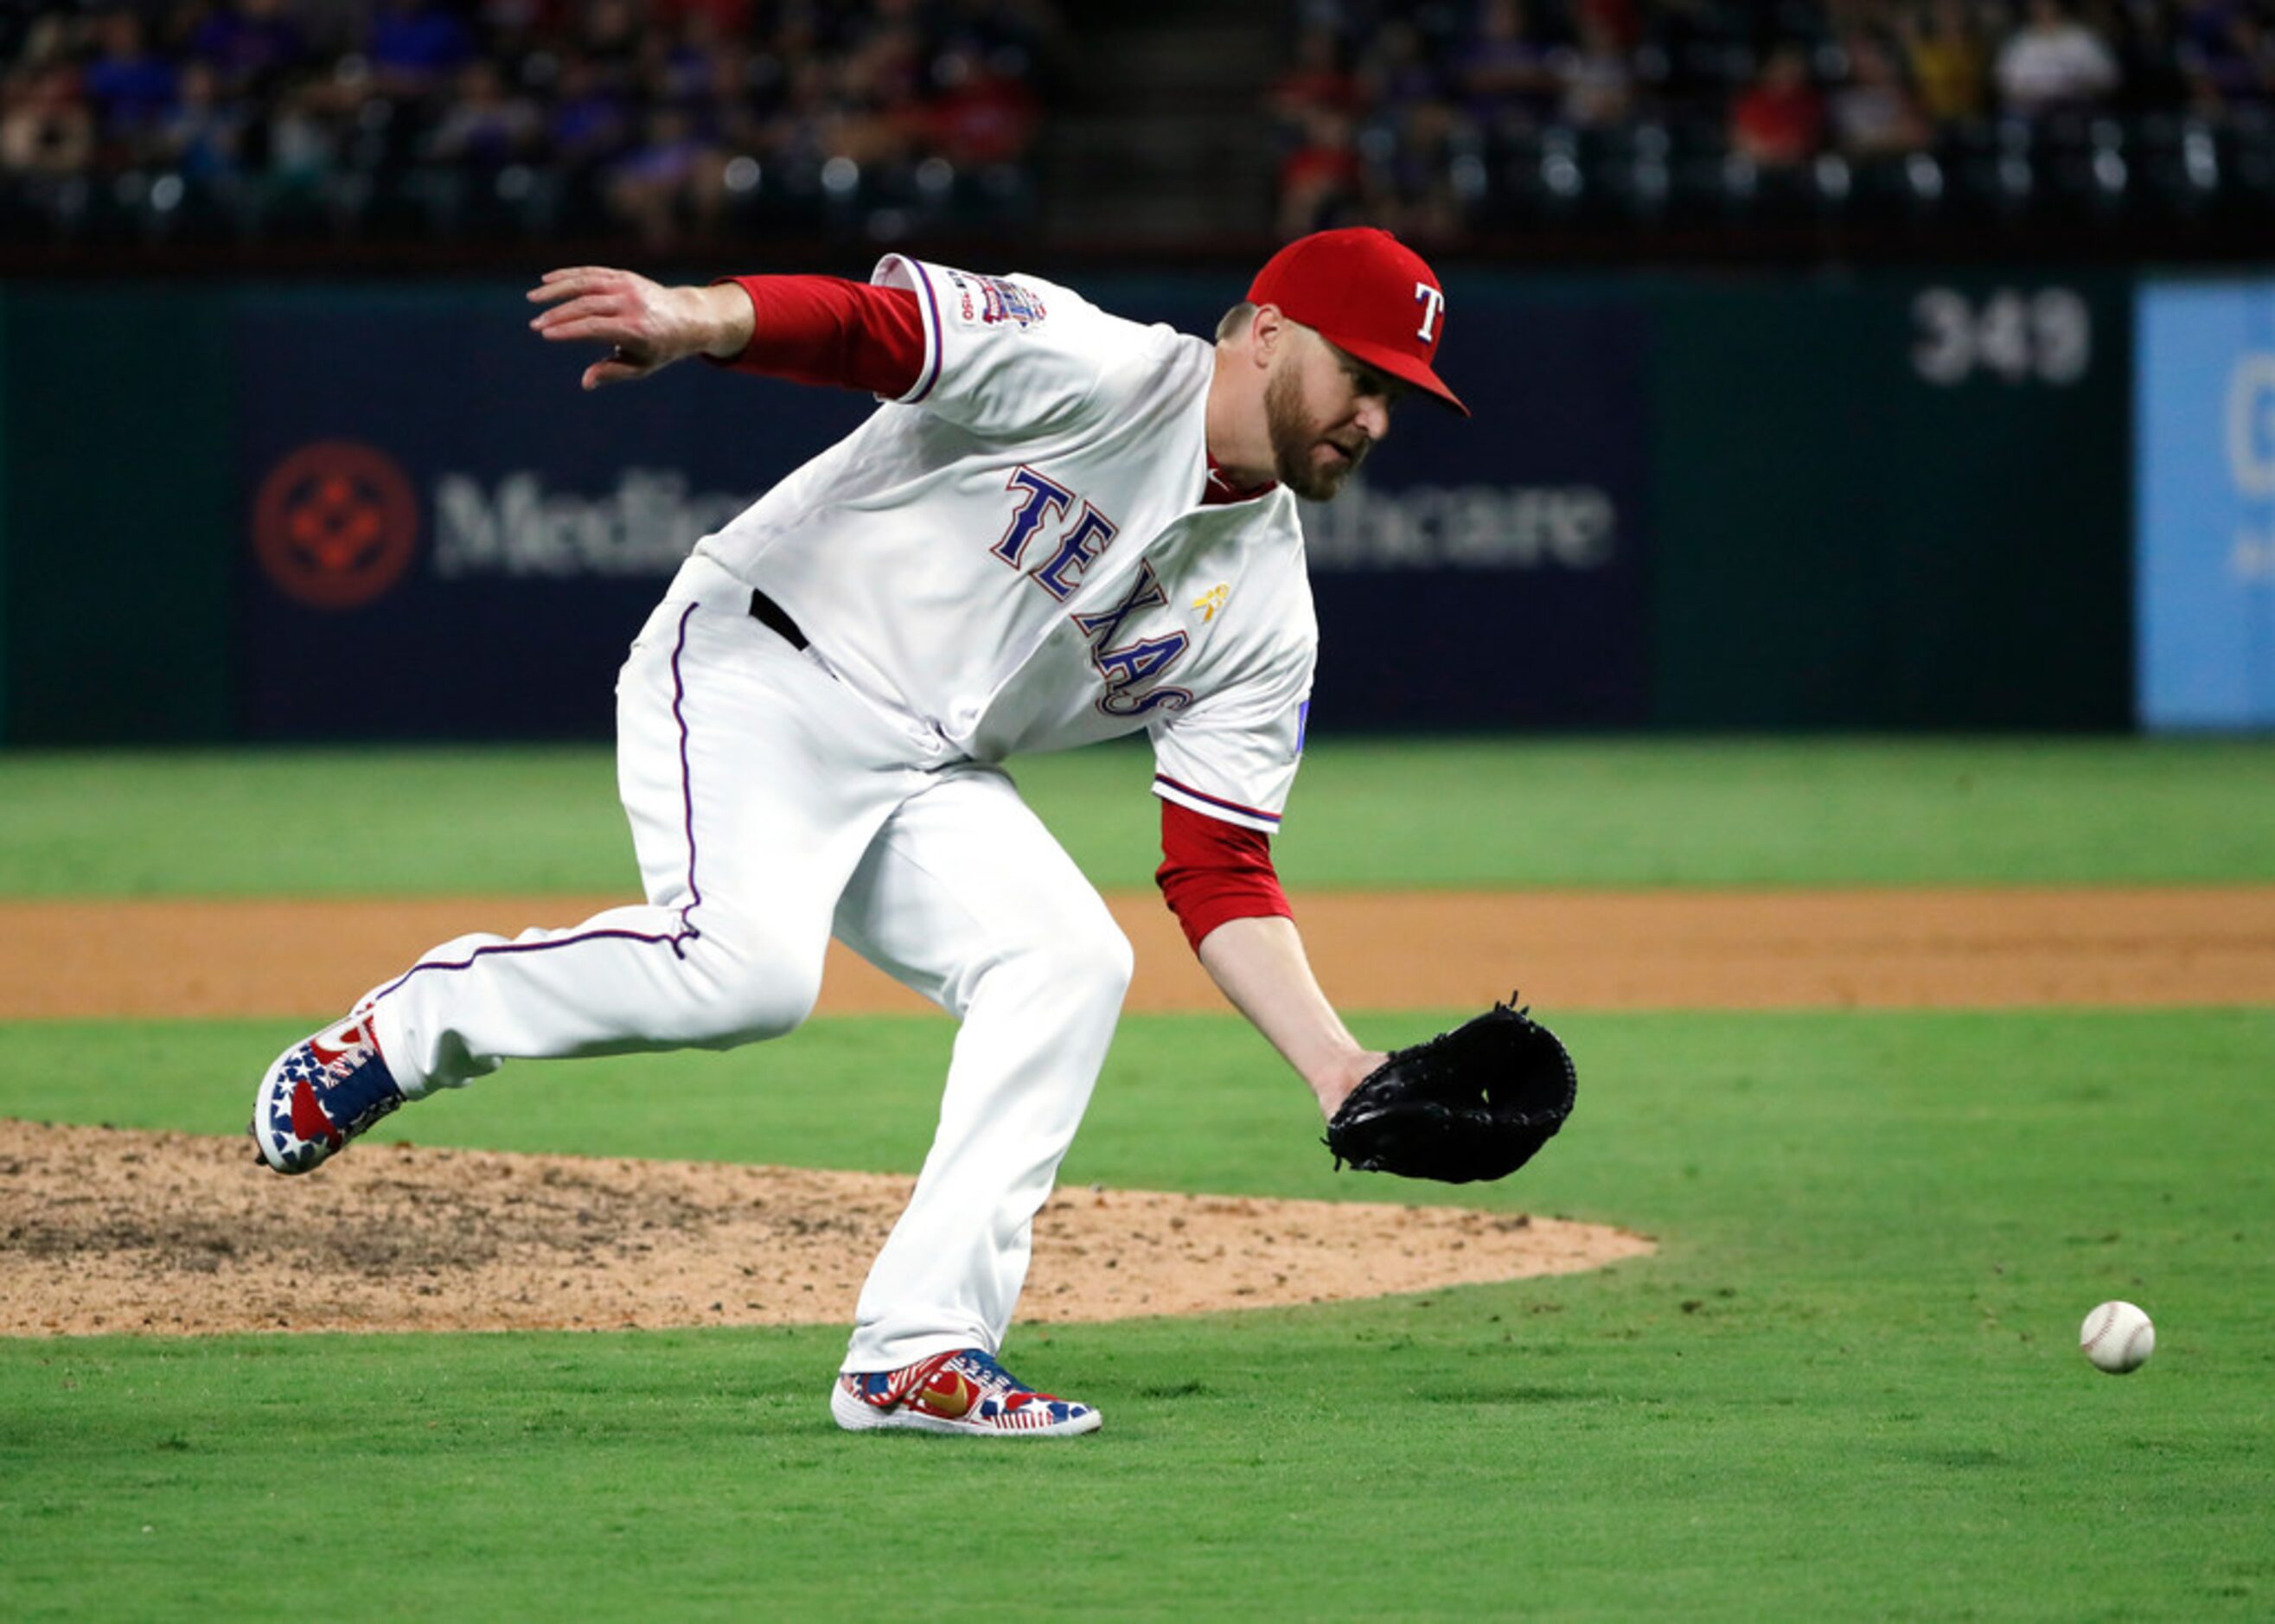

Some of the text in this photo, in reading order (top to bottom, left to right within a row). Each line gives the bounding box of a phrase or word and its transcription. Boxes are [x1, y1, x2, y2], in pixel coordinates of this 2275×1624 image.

[1415, 281, 1445, 343] T
[1913, 288, 2091, 385] 349
[436, 467, 751, 576] Medic
[989, 463, 1193, 716] TEXAS
